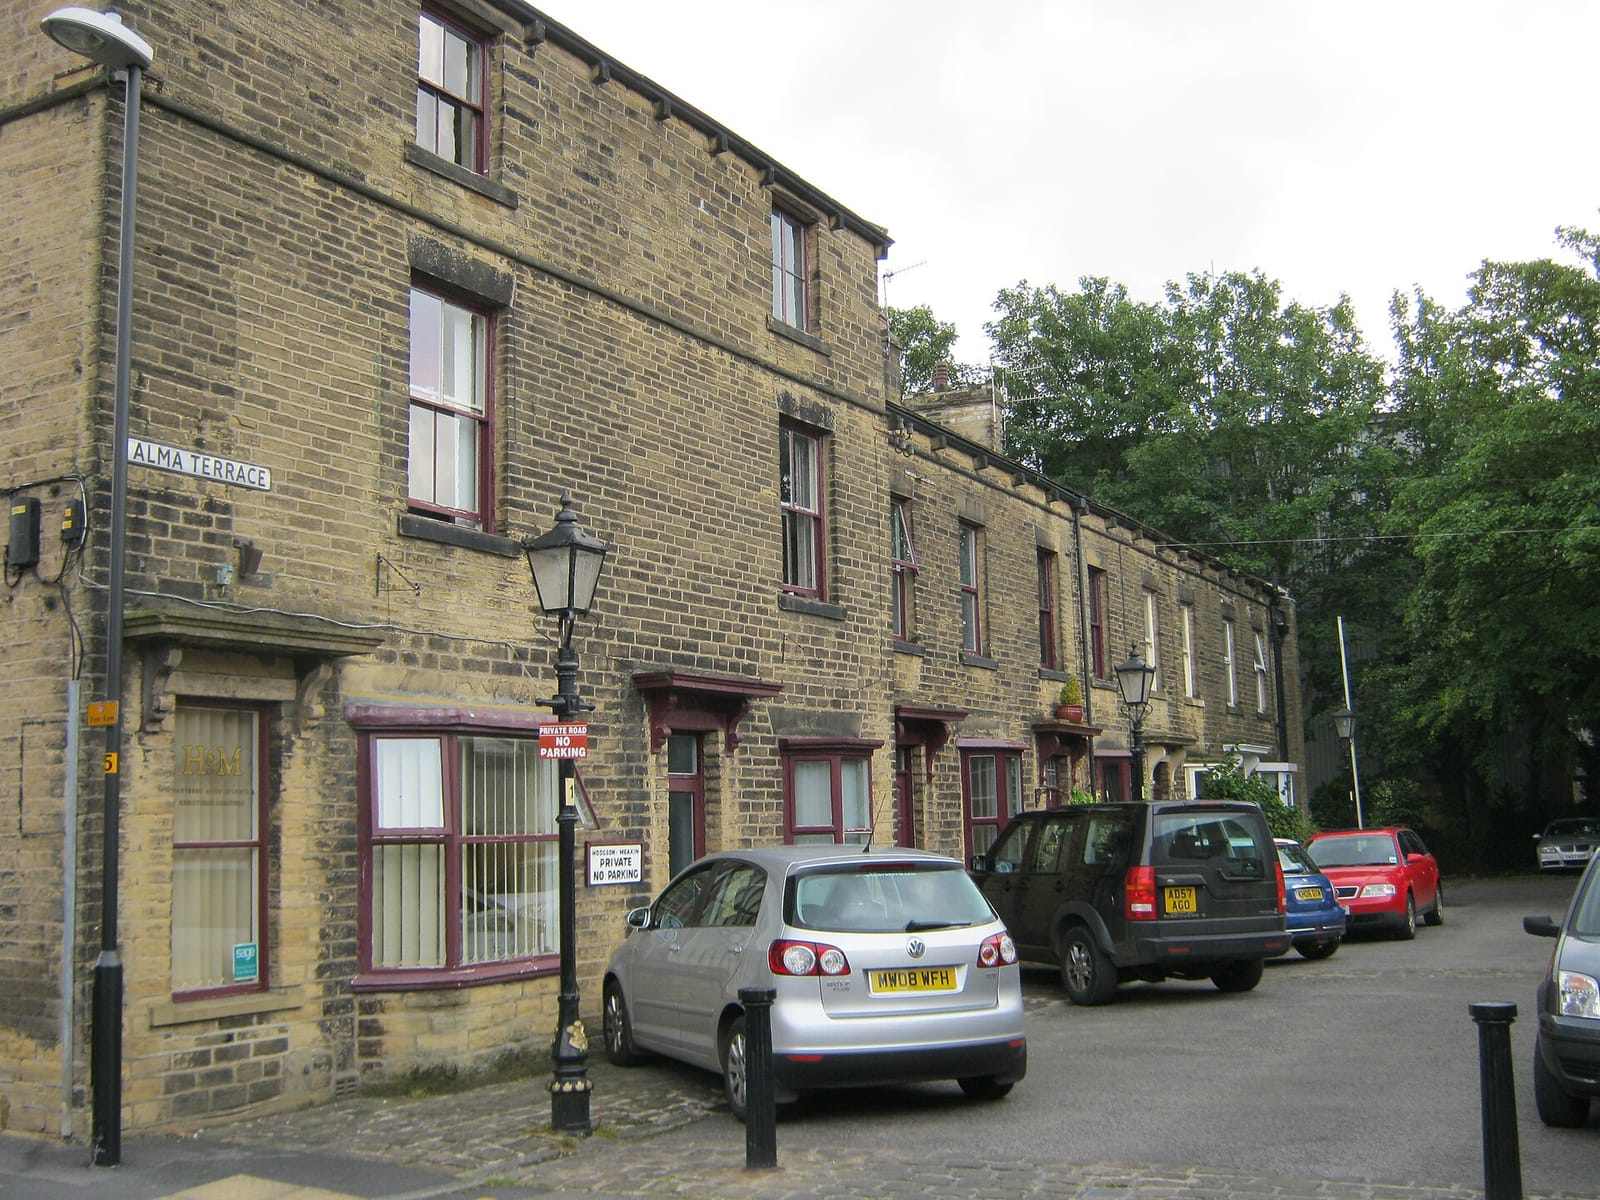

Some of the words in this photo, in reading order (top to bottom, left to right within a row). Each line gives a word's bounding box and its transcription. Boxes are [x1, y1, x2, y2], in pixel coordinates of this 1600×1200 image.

[133, 442, 183, 470] ALMA
[191, 454, 266, 487] TERRACE
[540, 727, 567, 735] PRIVATE
[569, 726, 587, 734] ROAD
[555, 736, 570, 746] NO
[540, 747, 586, 758] PARKING
[600, 857, 632, 867] PRIVATE
[593, 871, 604, 881] NO
[607, 869, 639, 880] PARKING
[1168, 889, 1192, 898] AD57
[878, 972, 918, 988] MW08
[921, 970, 950, 986] WFH
